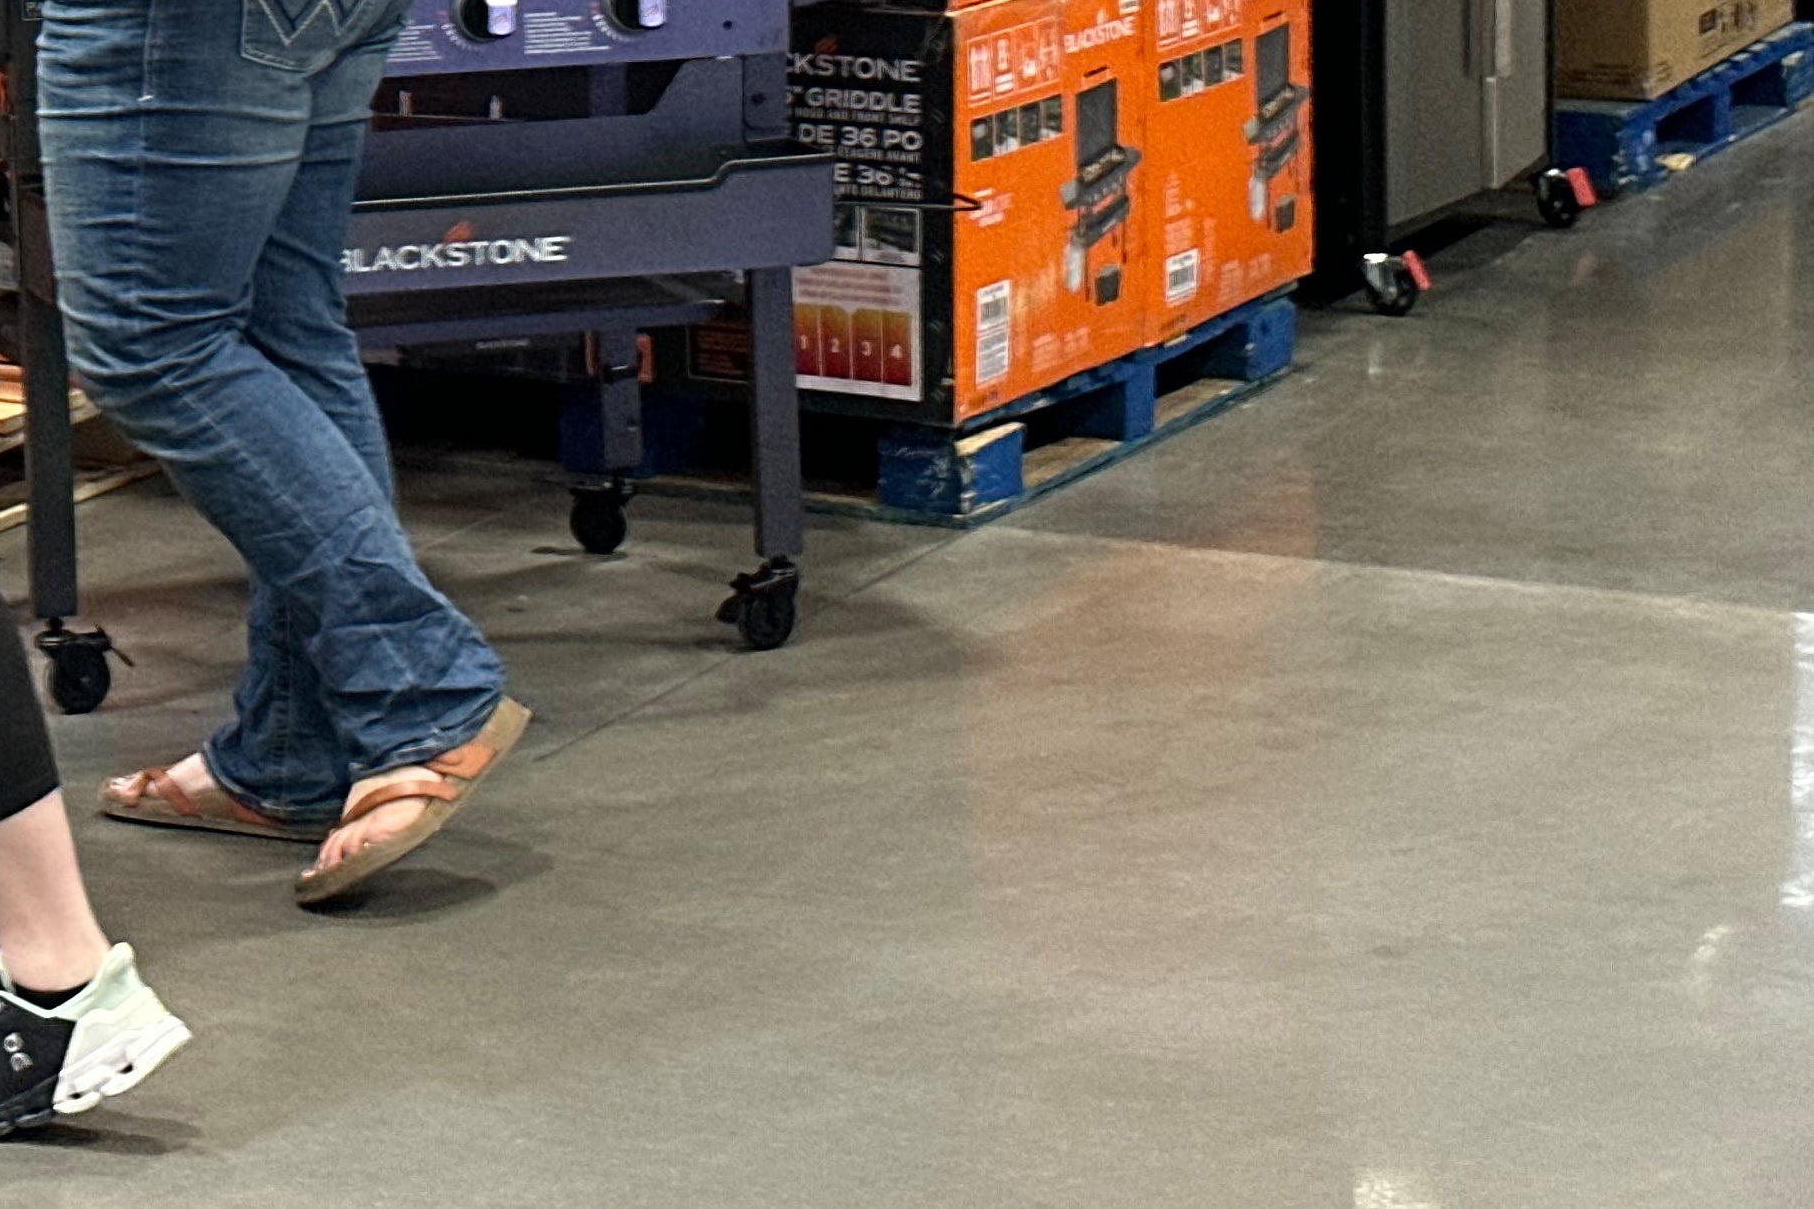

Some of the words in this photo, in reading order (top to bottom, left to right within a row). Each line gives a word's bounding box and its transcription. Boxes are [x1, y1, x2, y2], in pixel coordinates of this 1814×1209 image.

[1064, 16, 1136, 53] BLACKSTONE
[786, 51, 925, 83] KSTONE
[804, 87, 922, 114] GRIDDLE
[798, 123, 835, 145] DE
[840, 126, 878, 148] 36
[883, 129, 924, 151] PO
[833, 162, 853, 183] E
[855, 165, 894, 186] 36
[339, 235, 572, 273] BLACKSTONE
[831, 338, 840, 353] 2
[860, 340, 872, 356] 3
[890, 344, 903, 359] 4
